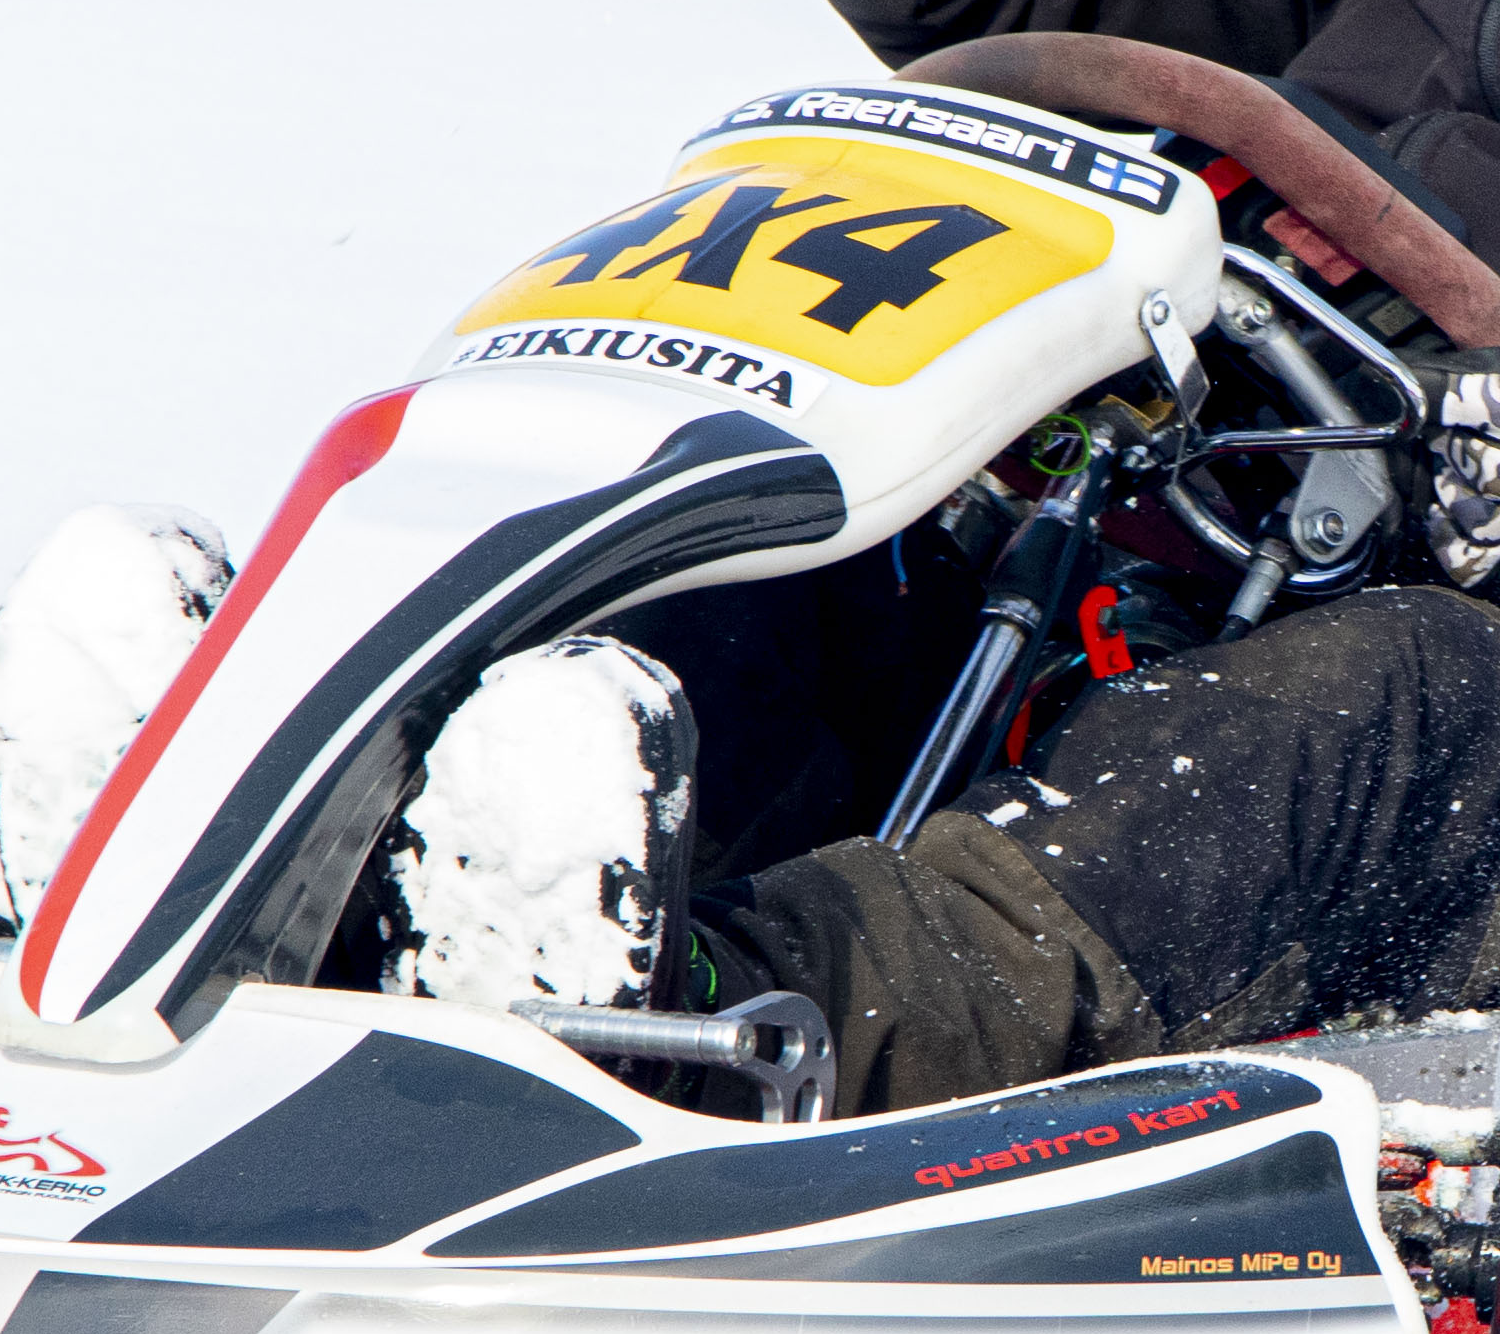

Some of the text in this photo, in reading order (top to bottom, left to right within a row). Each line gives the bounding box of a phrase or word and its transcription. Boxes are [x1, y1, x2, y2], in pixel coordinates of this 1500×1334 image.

[784, 91, 1076, 171] Raetsaari
[914, 1089, 1241, 1188] quattro kart
[1141, 1250, 1341, 1276] Mainos MiPe Oy
